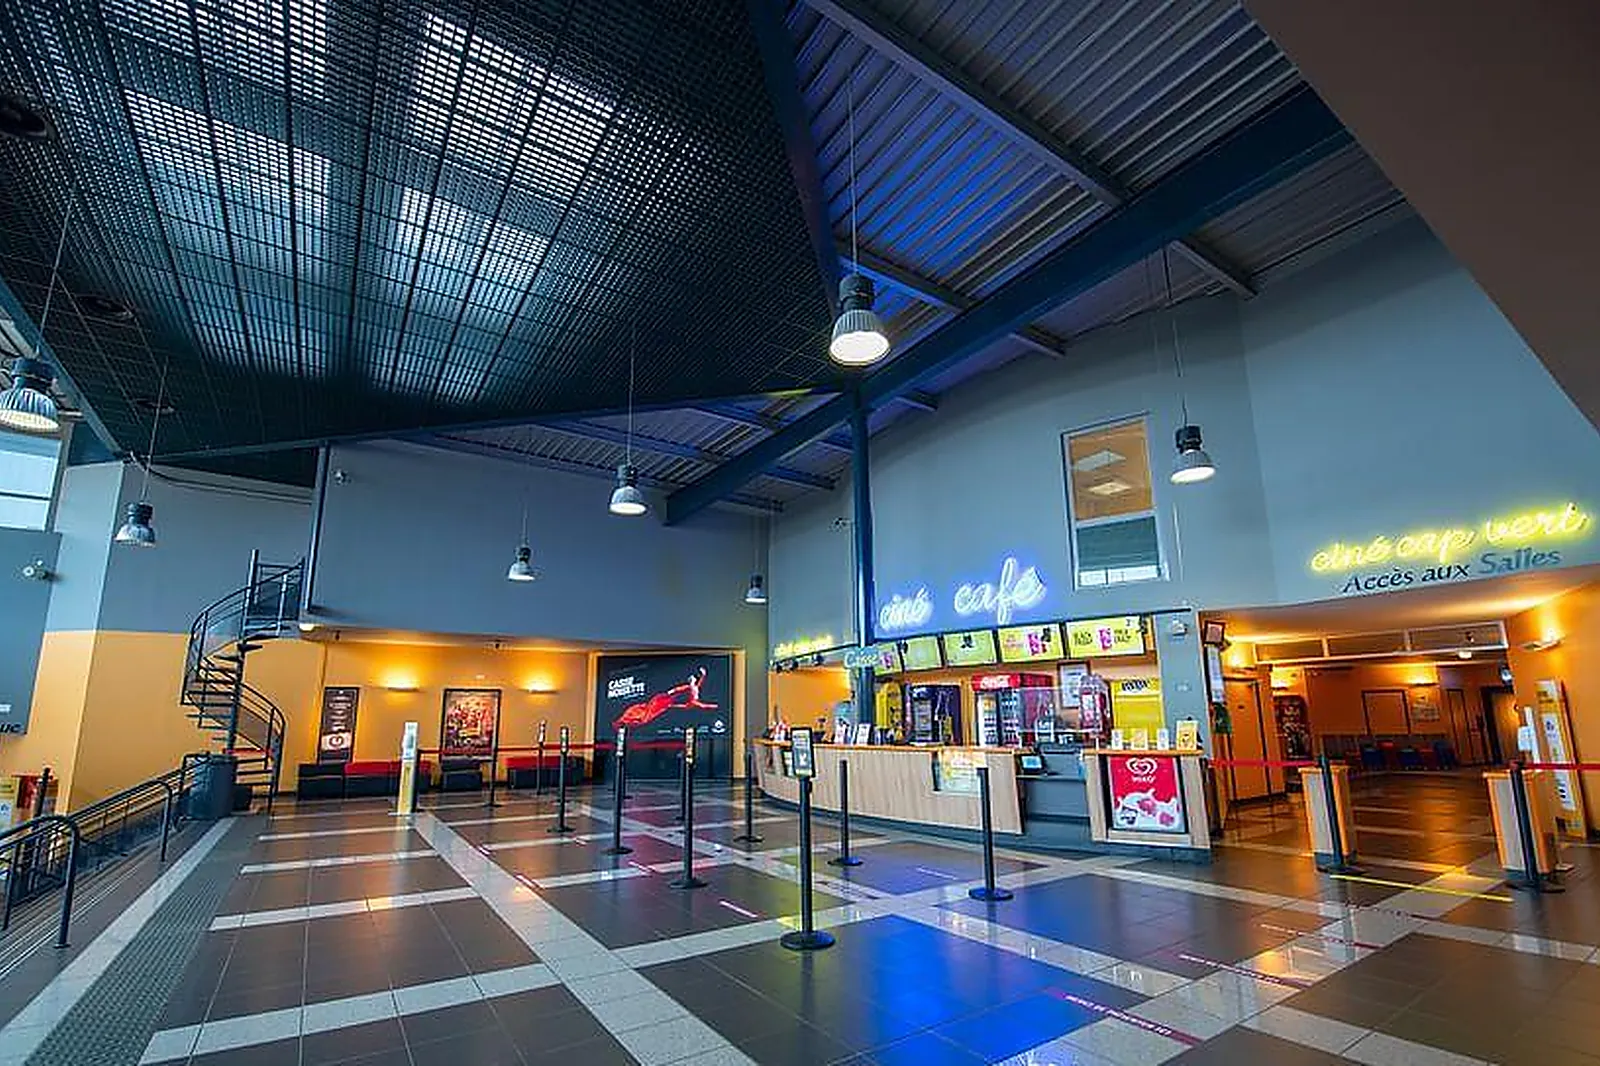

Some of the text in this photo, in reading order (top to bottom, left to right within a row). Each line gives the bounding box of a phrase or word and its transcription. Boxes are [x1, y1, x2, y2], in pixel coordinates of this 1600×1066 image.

[1395, 526, 1476, 564] cap
[1484, 501, 1590, 545] vert
[954, 556, 1047, 626] café
[1342, 547, 1561, 594] Accès aux Salles
